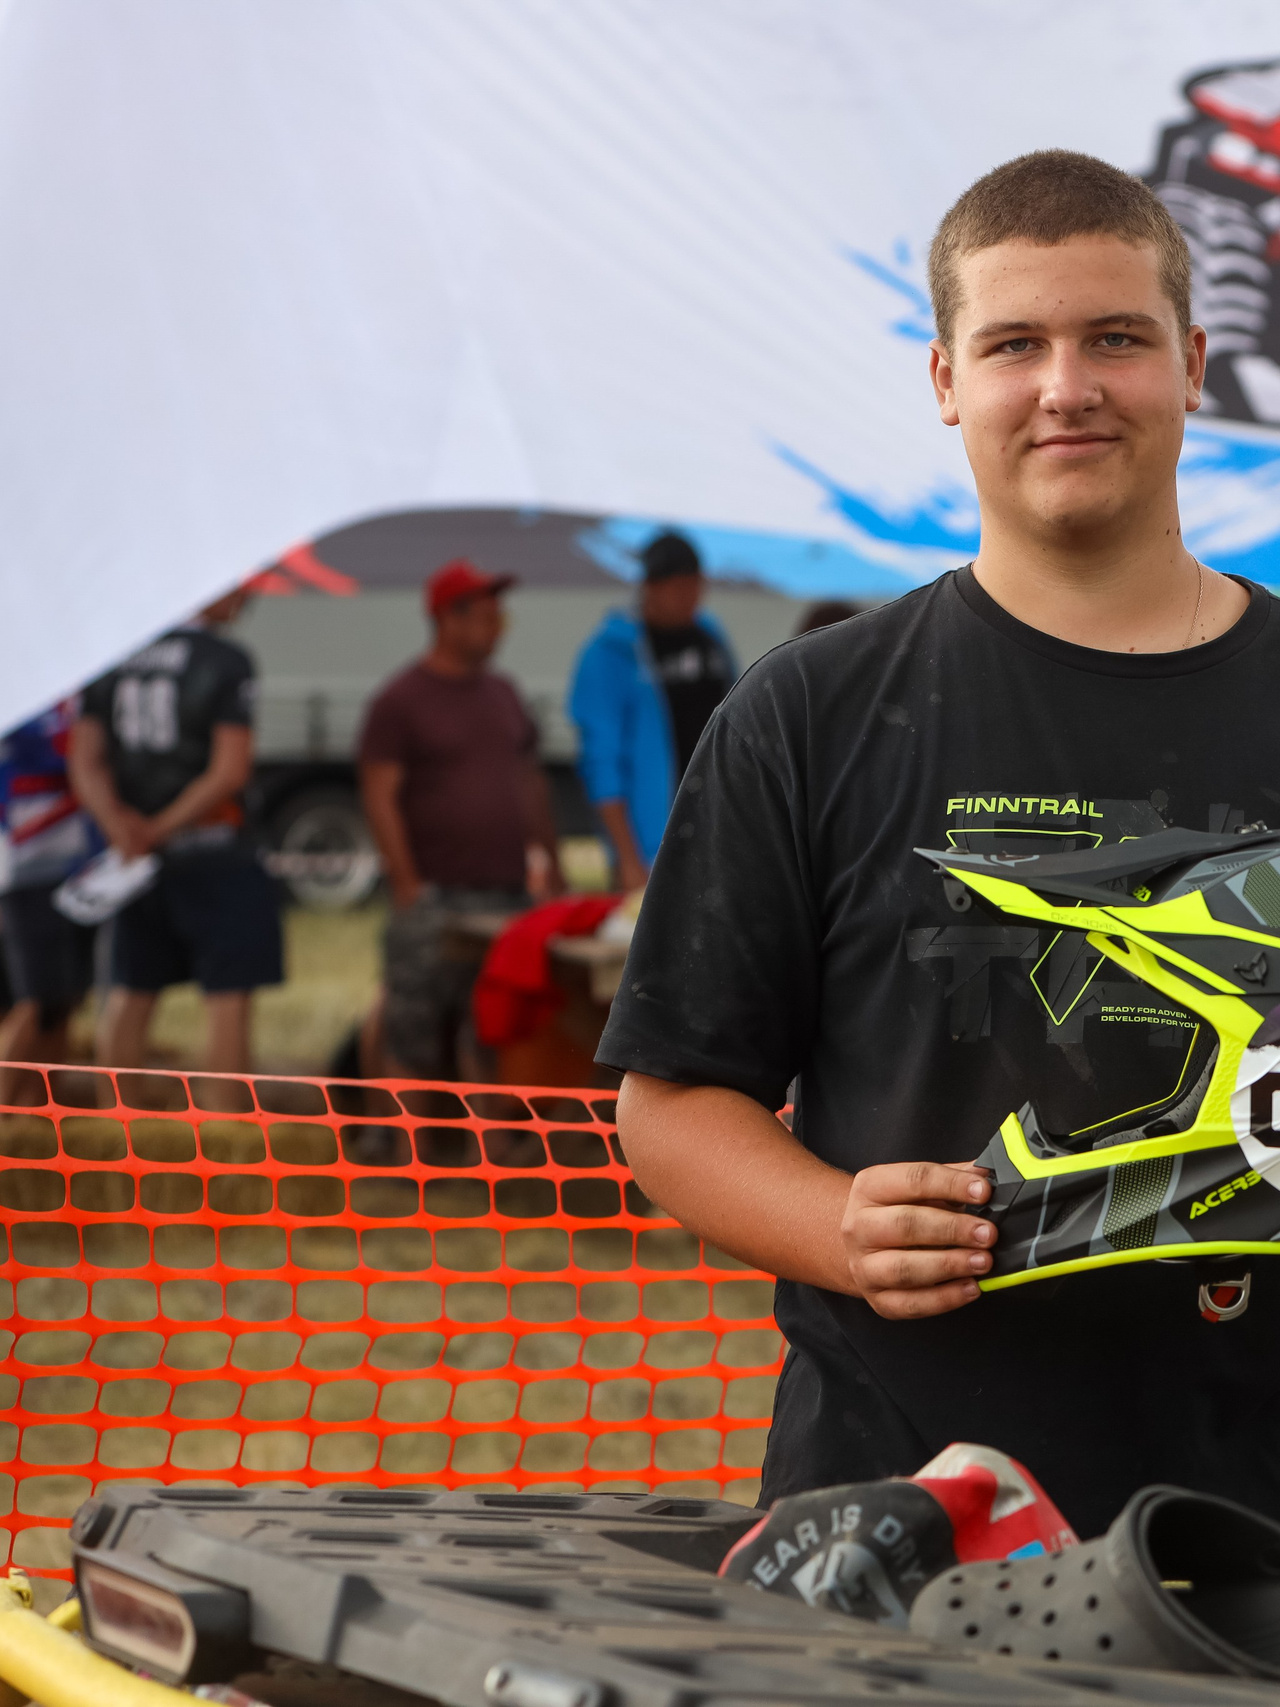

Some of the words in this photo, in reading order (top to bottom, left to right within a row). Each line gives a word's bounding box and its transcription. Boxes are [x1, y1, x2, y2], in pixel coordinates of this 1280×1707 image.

[946, 797, 1104, 818] FINNTRAIL
[1101, 1015, 1160, 1024] DEVELOPED
[1160, 1018, 1178, 1027] FOR
[1157, 1009, 1191, 1019] ADVEN
[746, 1519, 819, 1591] EAR
[831, 1503, 863, 1536] IS
